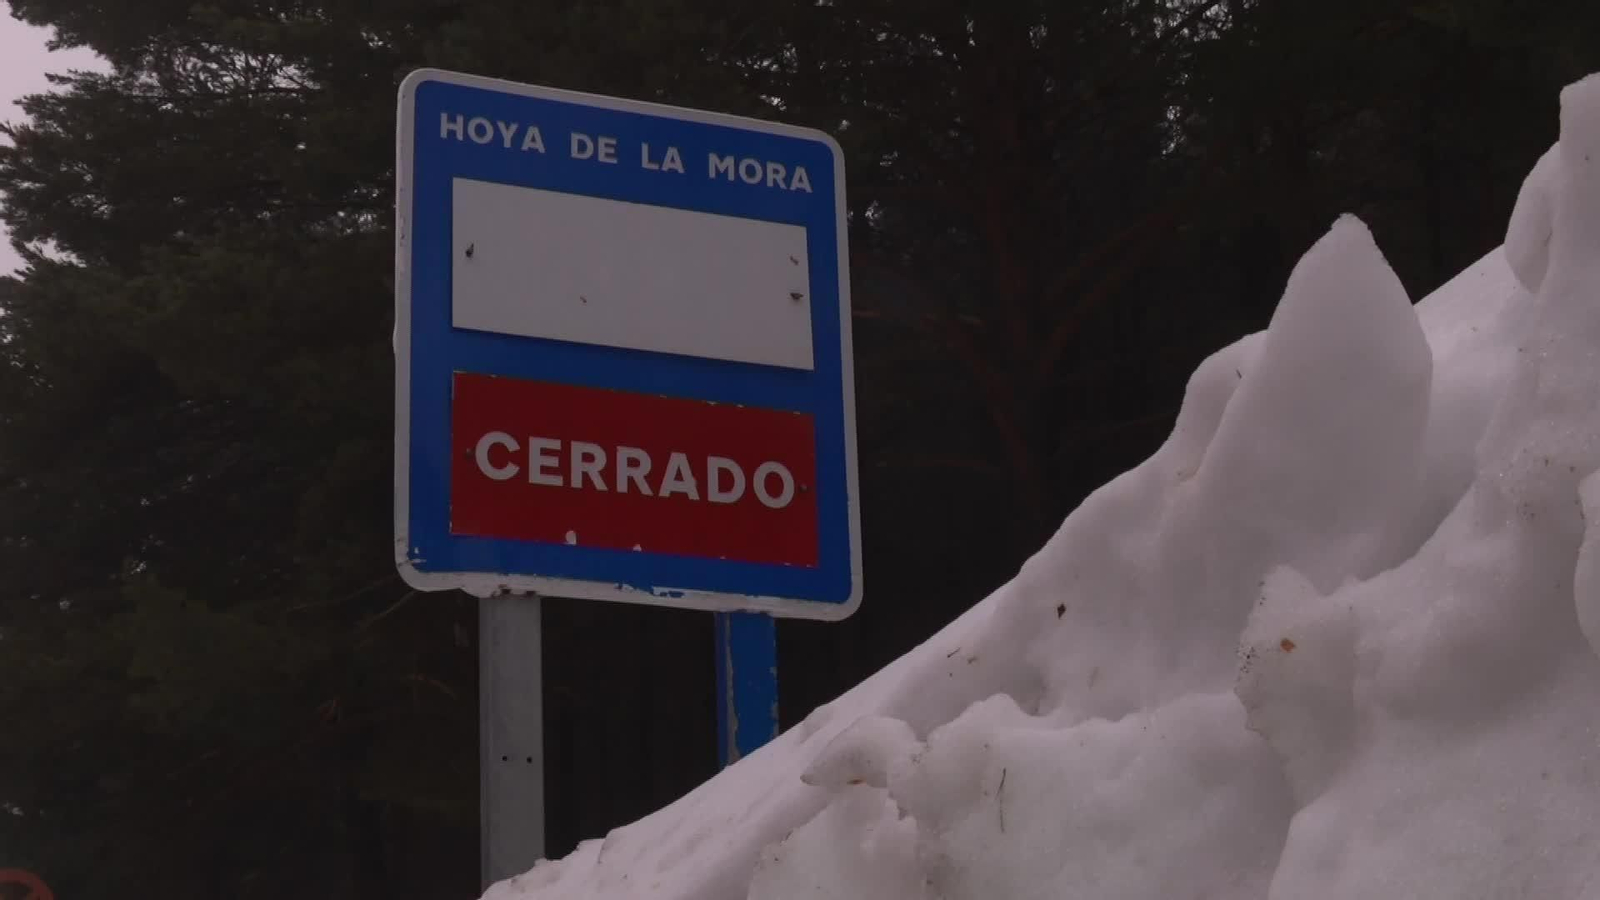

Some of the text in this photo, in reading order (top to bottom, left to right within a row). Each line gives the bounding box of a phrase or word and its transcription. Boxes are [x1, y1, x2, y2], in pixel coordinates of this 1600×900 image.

[439, 112, 813, 193] HOYA DE LA MORA
[474, 431, 795, 509] CERRADO
